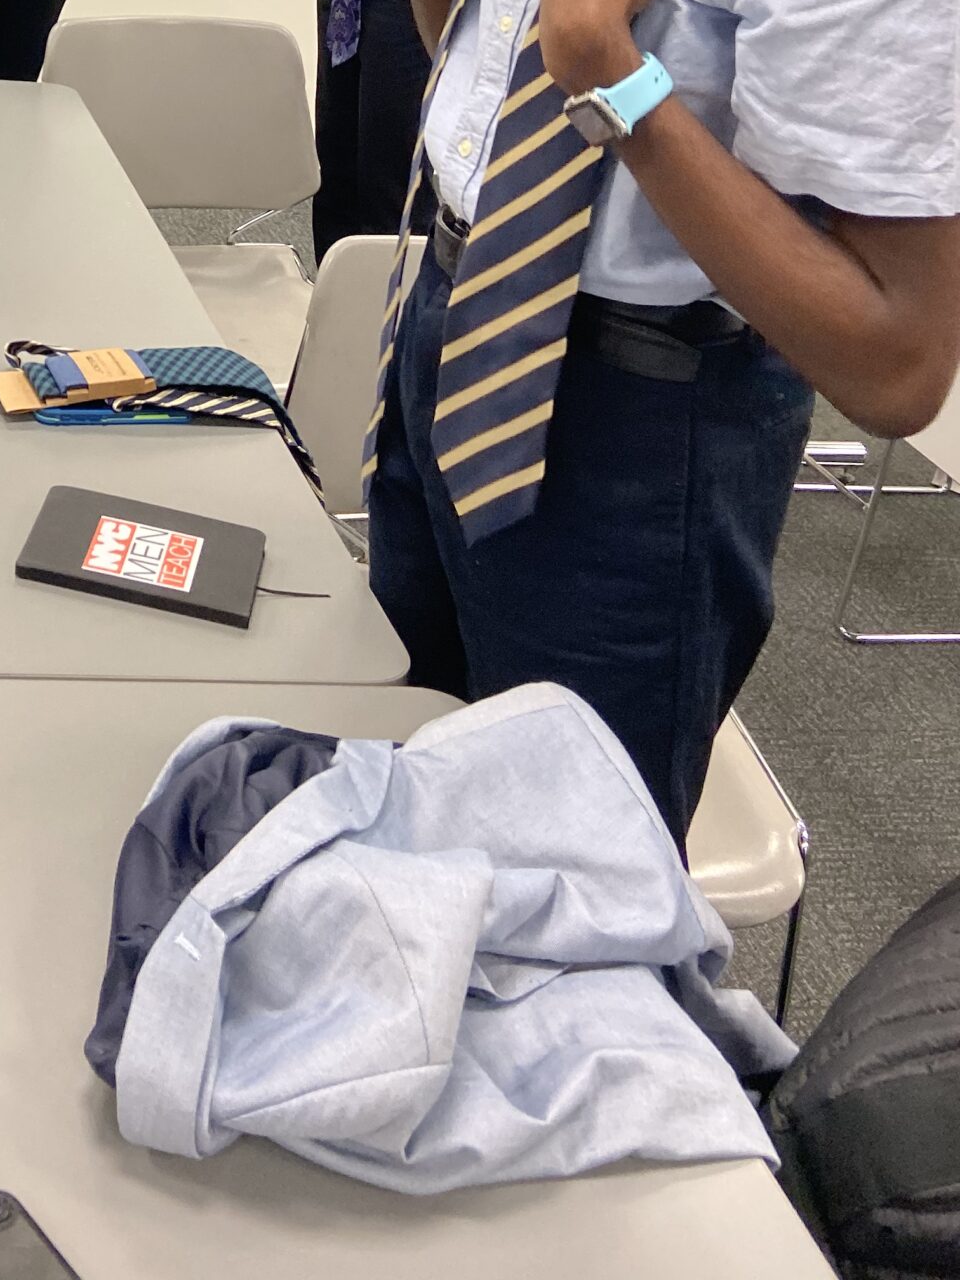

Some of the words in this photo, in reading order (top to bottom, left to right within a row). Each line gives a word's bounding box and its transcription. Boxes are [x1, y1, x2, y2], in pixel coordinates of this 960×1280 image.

[87, 521, 132, 571] NYC
[123, 526, 169, 583] MEN
[160, 534, 197, 584] TEACH
